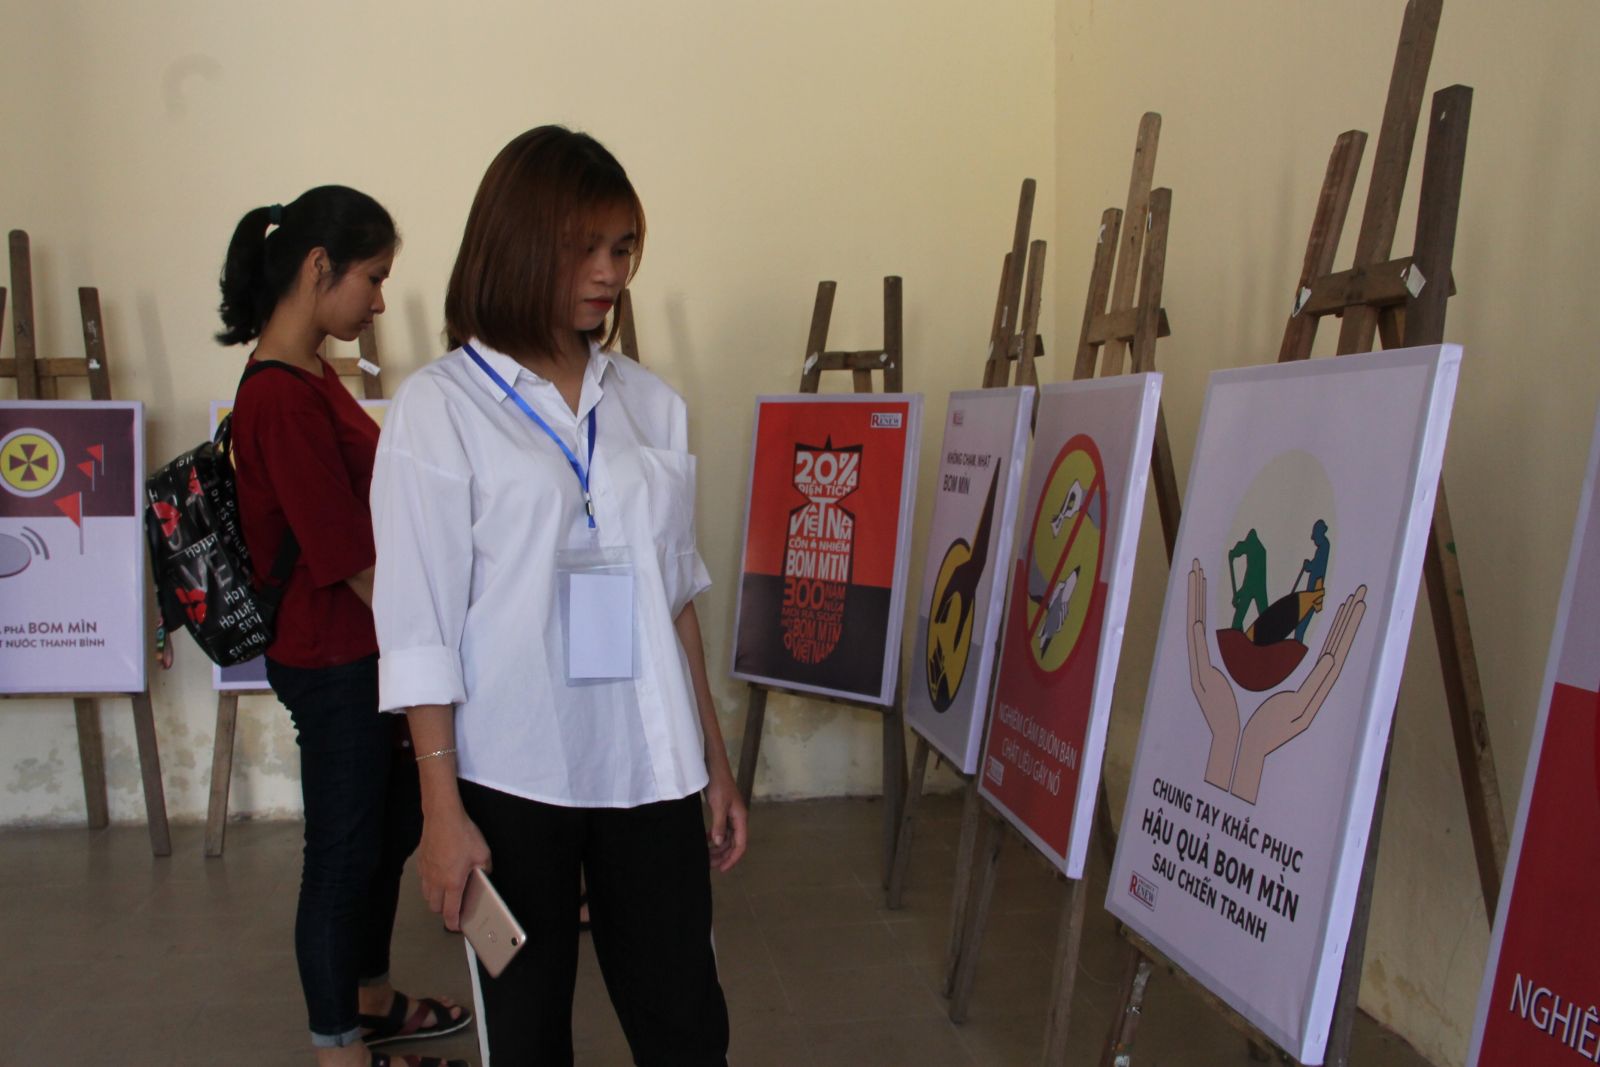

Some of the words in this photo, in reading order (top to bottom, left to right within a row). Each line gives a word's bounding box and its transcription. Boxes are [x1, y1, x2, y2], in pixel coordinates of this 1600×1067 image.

[794, 450, 860, 487] 20%
[785, 549, 817, 580] BOM
[783, 577, 825, 610] 300
[28, 621, 64, 634] BOM
[68, 618, 97, 634] MÌN
[40, 639, 77, 649] THANH
[79, 636, 105, 648] BÌNH
[1152, 777, 1193, 814] CHUNG
[1195, 798, 1222, 828] TAY
[1220, 815, 1260, 850] KHẮC
[1260, 832, 1305, 873] PHỤC
[1142, 806, 1174, 846] HẬU
[1176, 828, 1211, 870] QUẢ
[1213, 850, 1255, 895] BOM
[1256, 872, 1300, 923] MÌN
[1151, 852, 1177, 882] SAU
[1219, 894, 1268, 943] TRANH
[1509, 972, 1600, 1063] NGHIÊ
